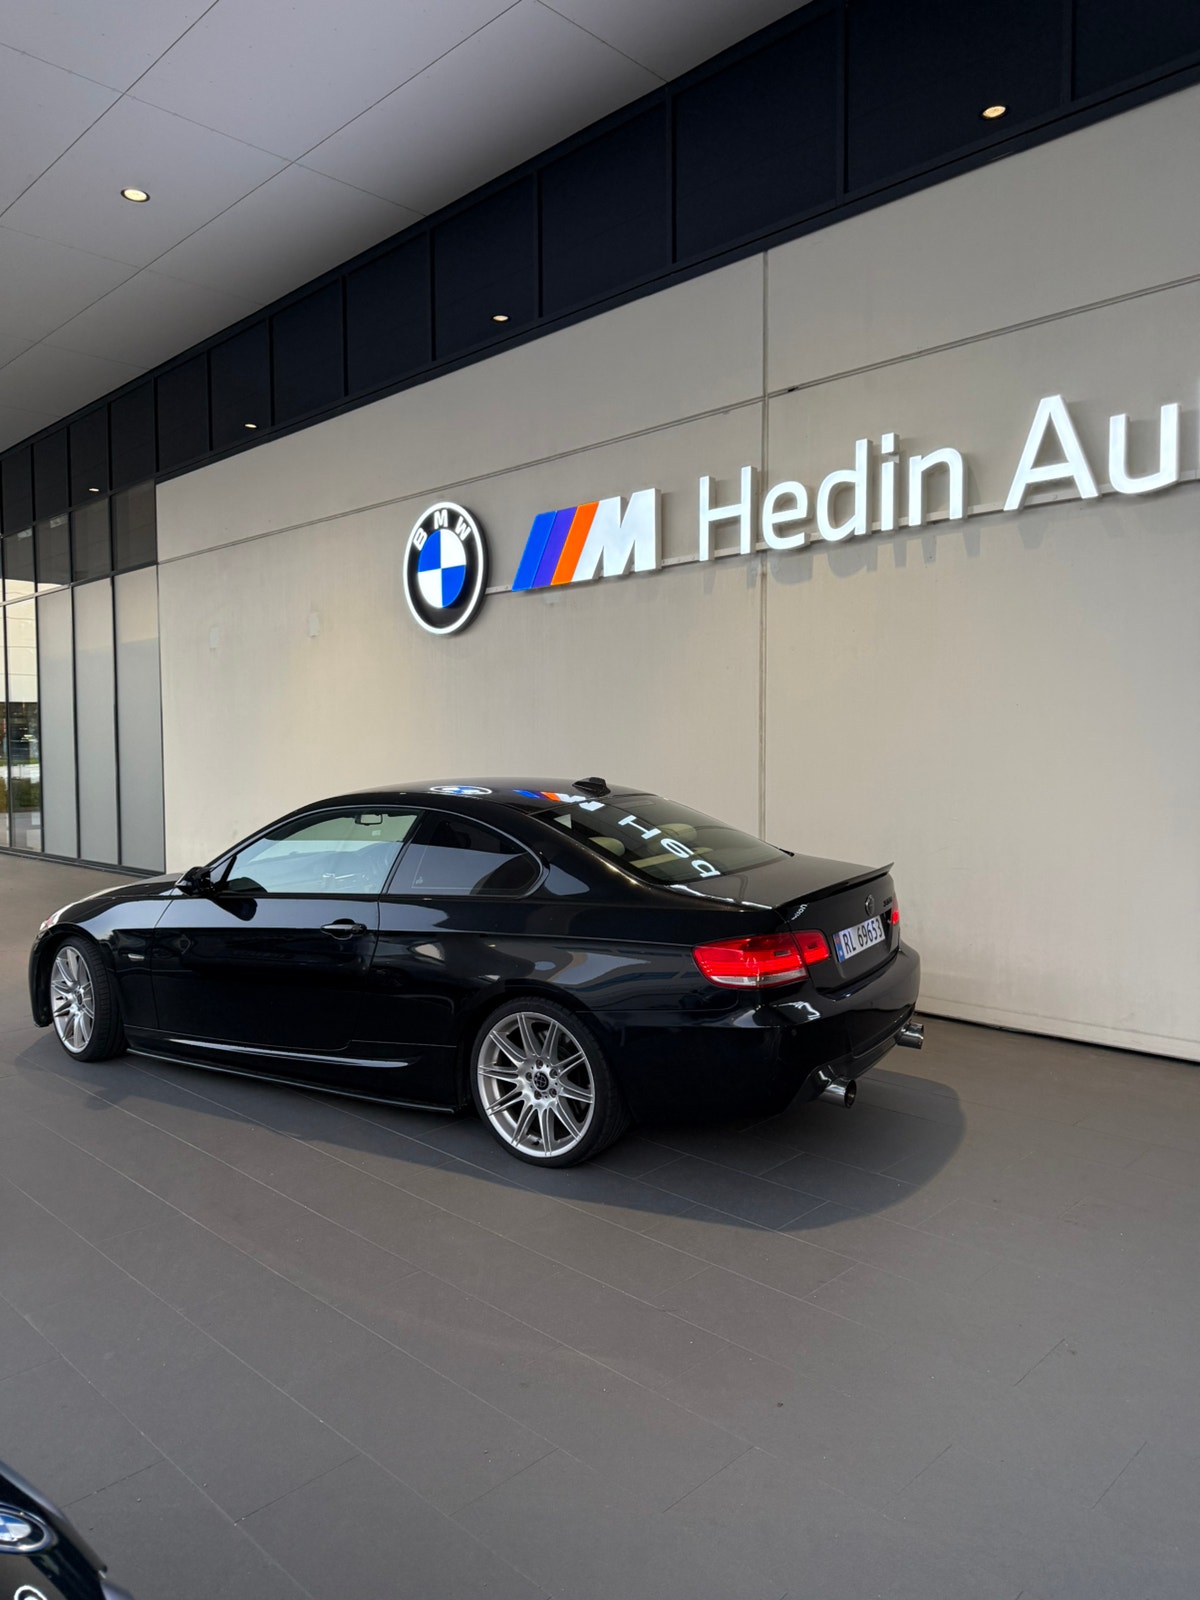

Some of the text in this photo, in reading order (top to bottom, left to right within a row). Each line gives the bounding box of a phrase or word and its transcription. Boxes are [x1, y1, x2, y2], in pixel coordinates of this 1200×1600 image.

[698, 394, 1200, 561] Hedin Au
[413, 508, 472, 551] BMW
[570, 487, 662, 583] M
[842, 918, 883, 955] RL 69653
